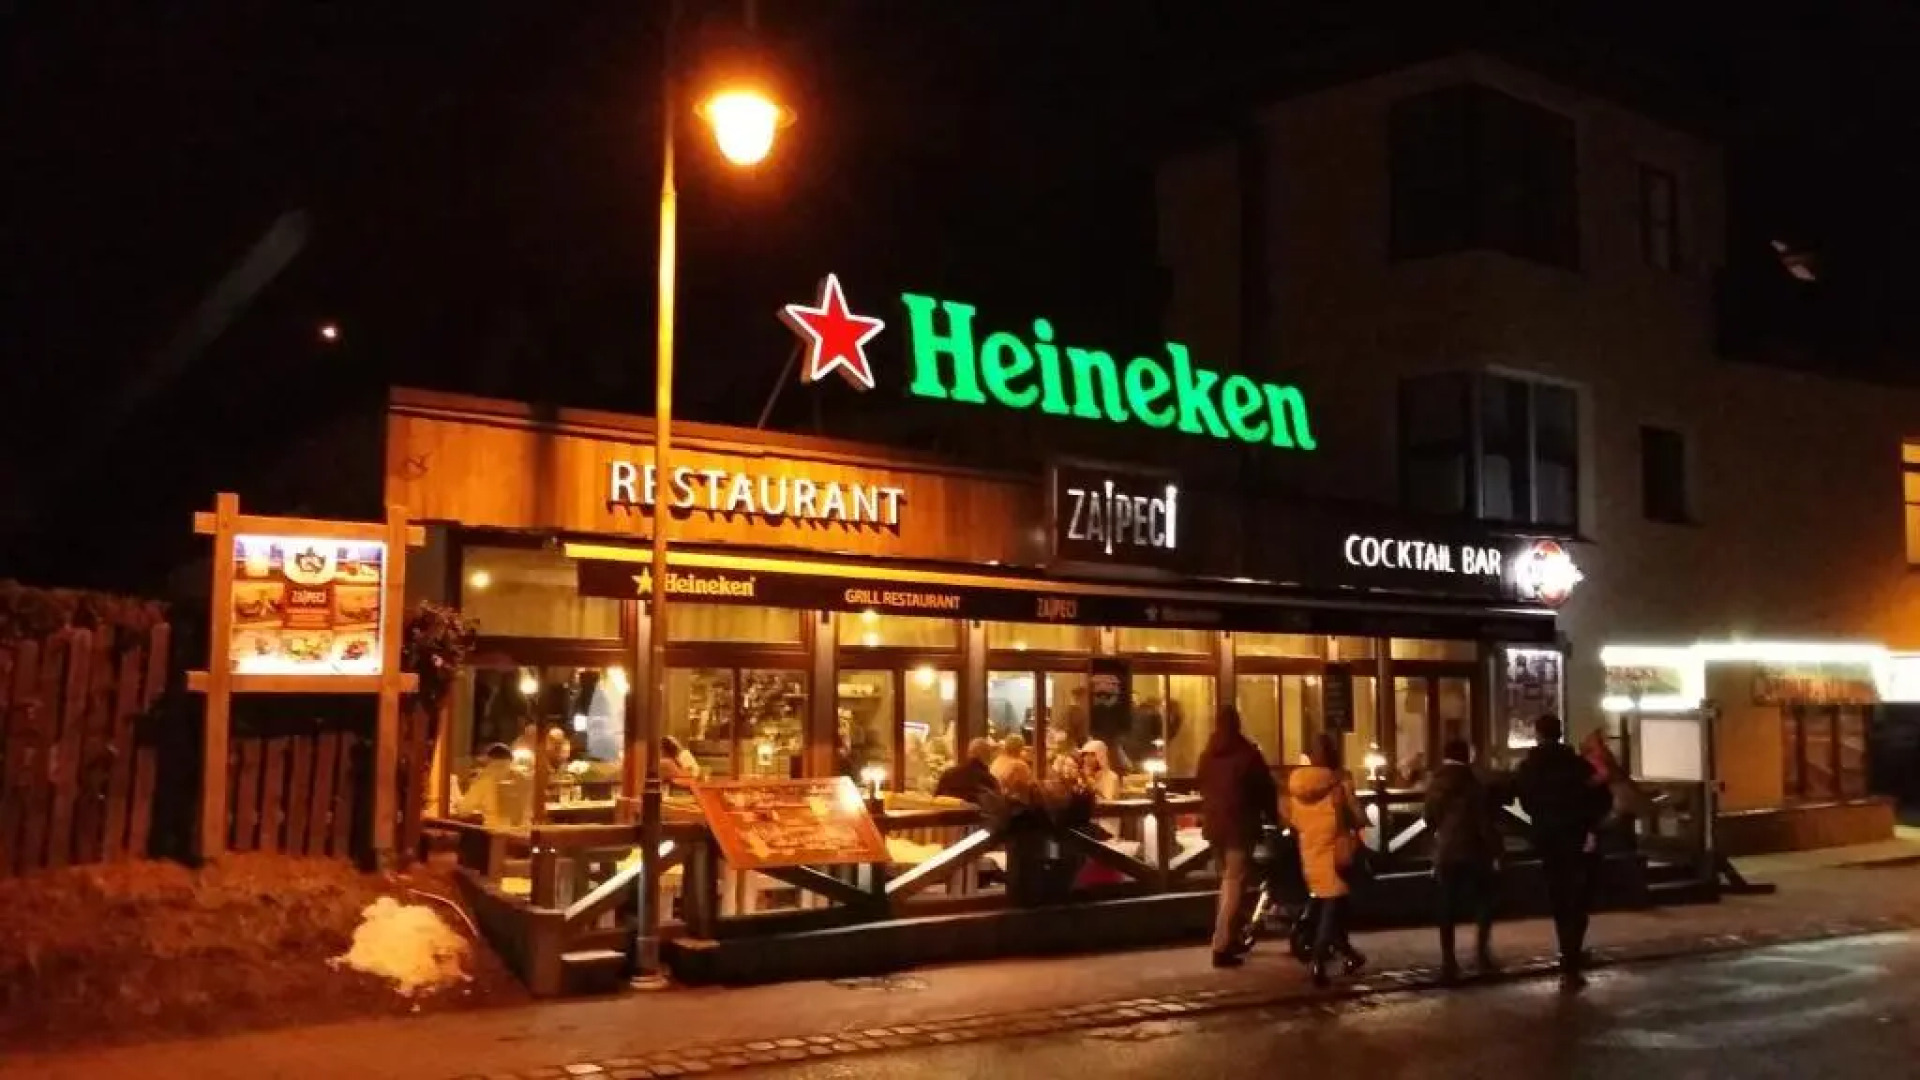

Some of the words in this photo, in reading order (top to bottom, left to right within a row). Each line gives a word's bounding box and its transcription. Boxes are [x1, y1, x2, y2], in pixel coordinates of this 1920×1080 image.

[901, 292, 1317, 450] Heineken
[610, 460, 905, 524] RESTAURANT
[1345, 533, 1455, 573] COCKTAIL
[1462, 545, 1502, 576] BAR
[664, 573, 754, 596] Heineken
[844, 588, 882, 604] GRILL
[883, 591, 960, 609] RESTAURANT
